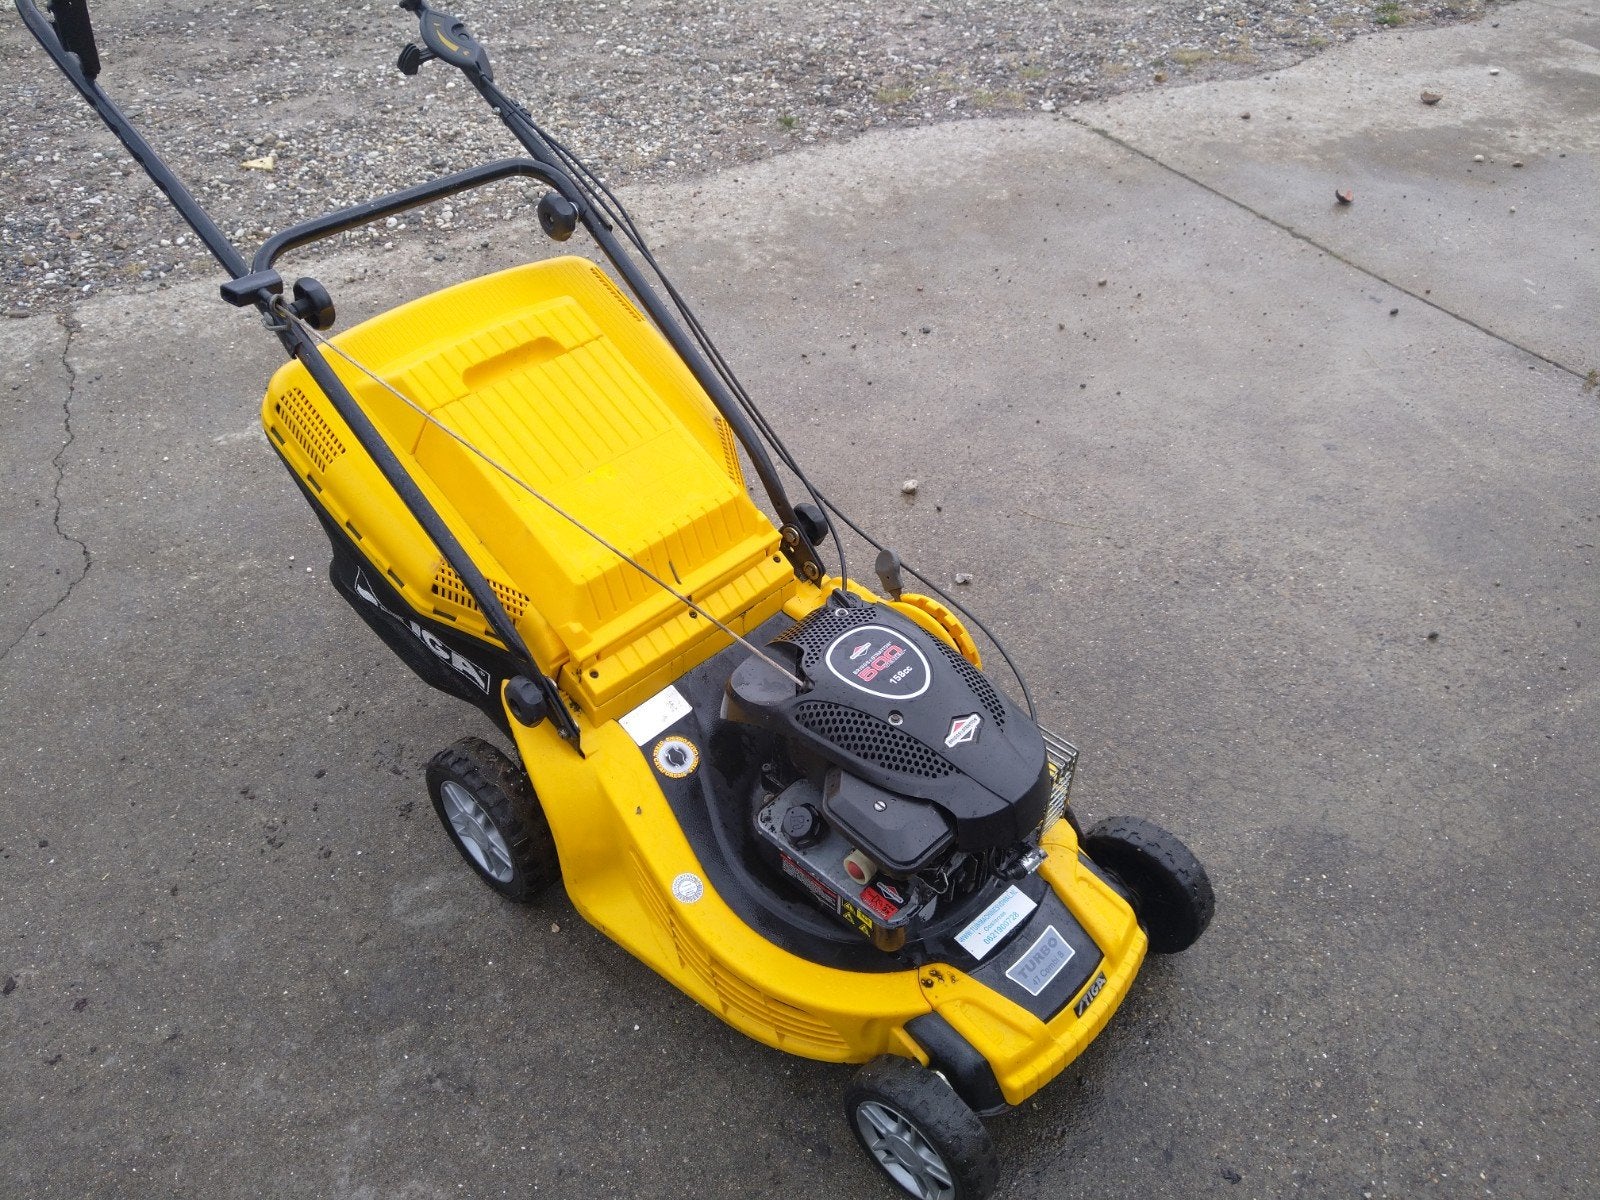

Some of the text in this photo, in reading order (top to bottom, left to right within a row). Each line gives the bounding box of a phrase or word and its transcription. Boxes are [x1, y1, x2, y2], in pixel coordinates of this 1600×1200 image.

[857, 644, 904, 682] 500
[889, 665, 913, 685] 158cc
[1018, 936, 1059, 980] TURBO
[1032, 950, 1065, 987] 47 Combi B
[1077, 976, 1107, 1015] STIGA
